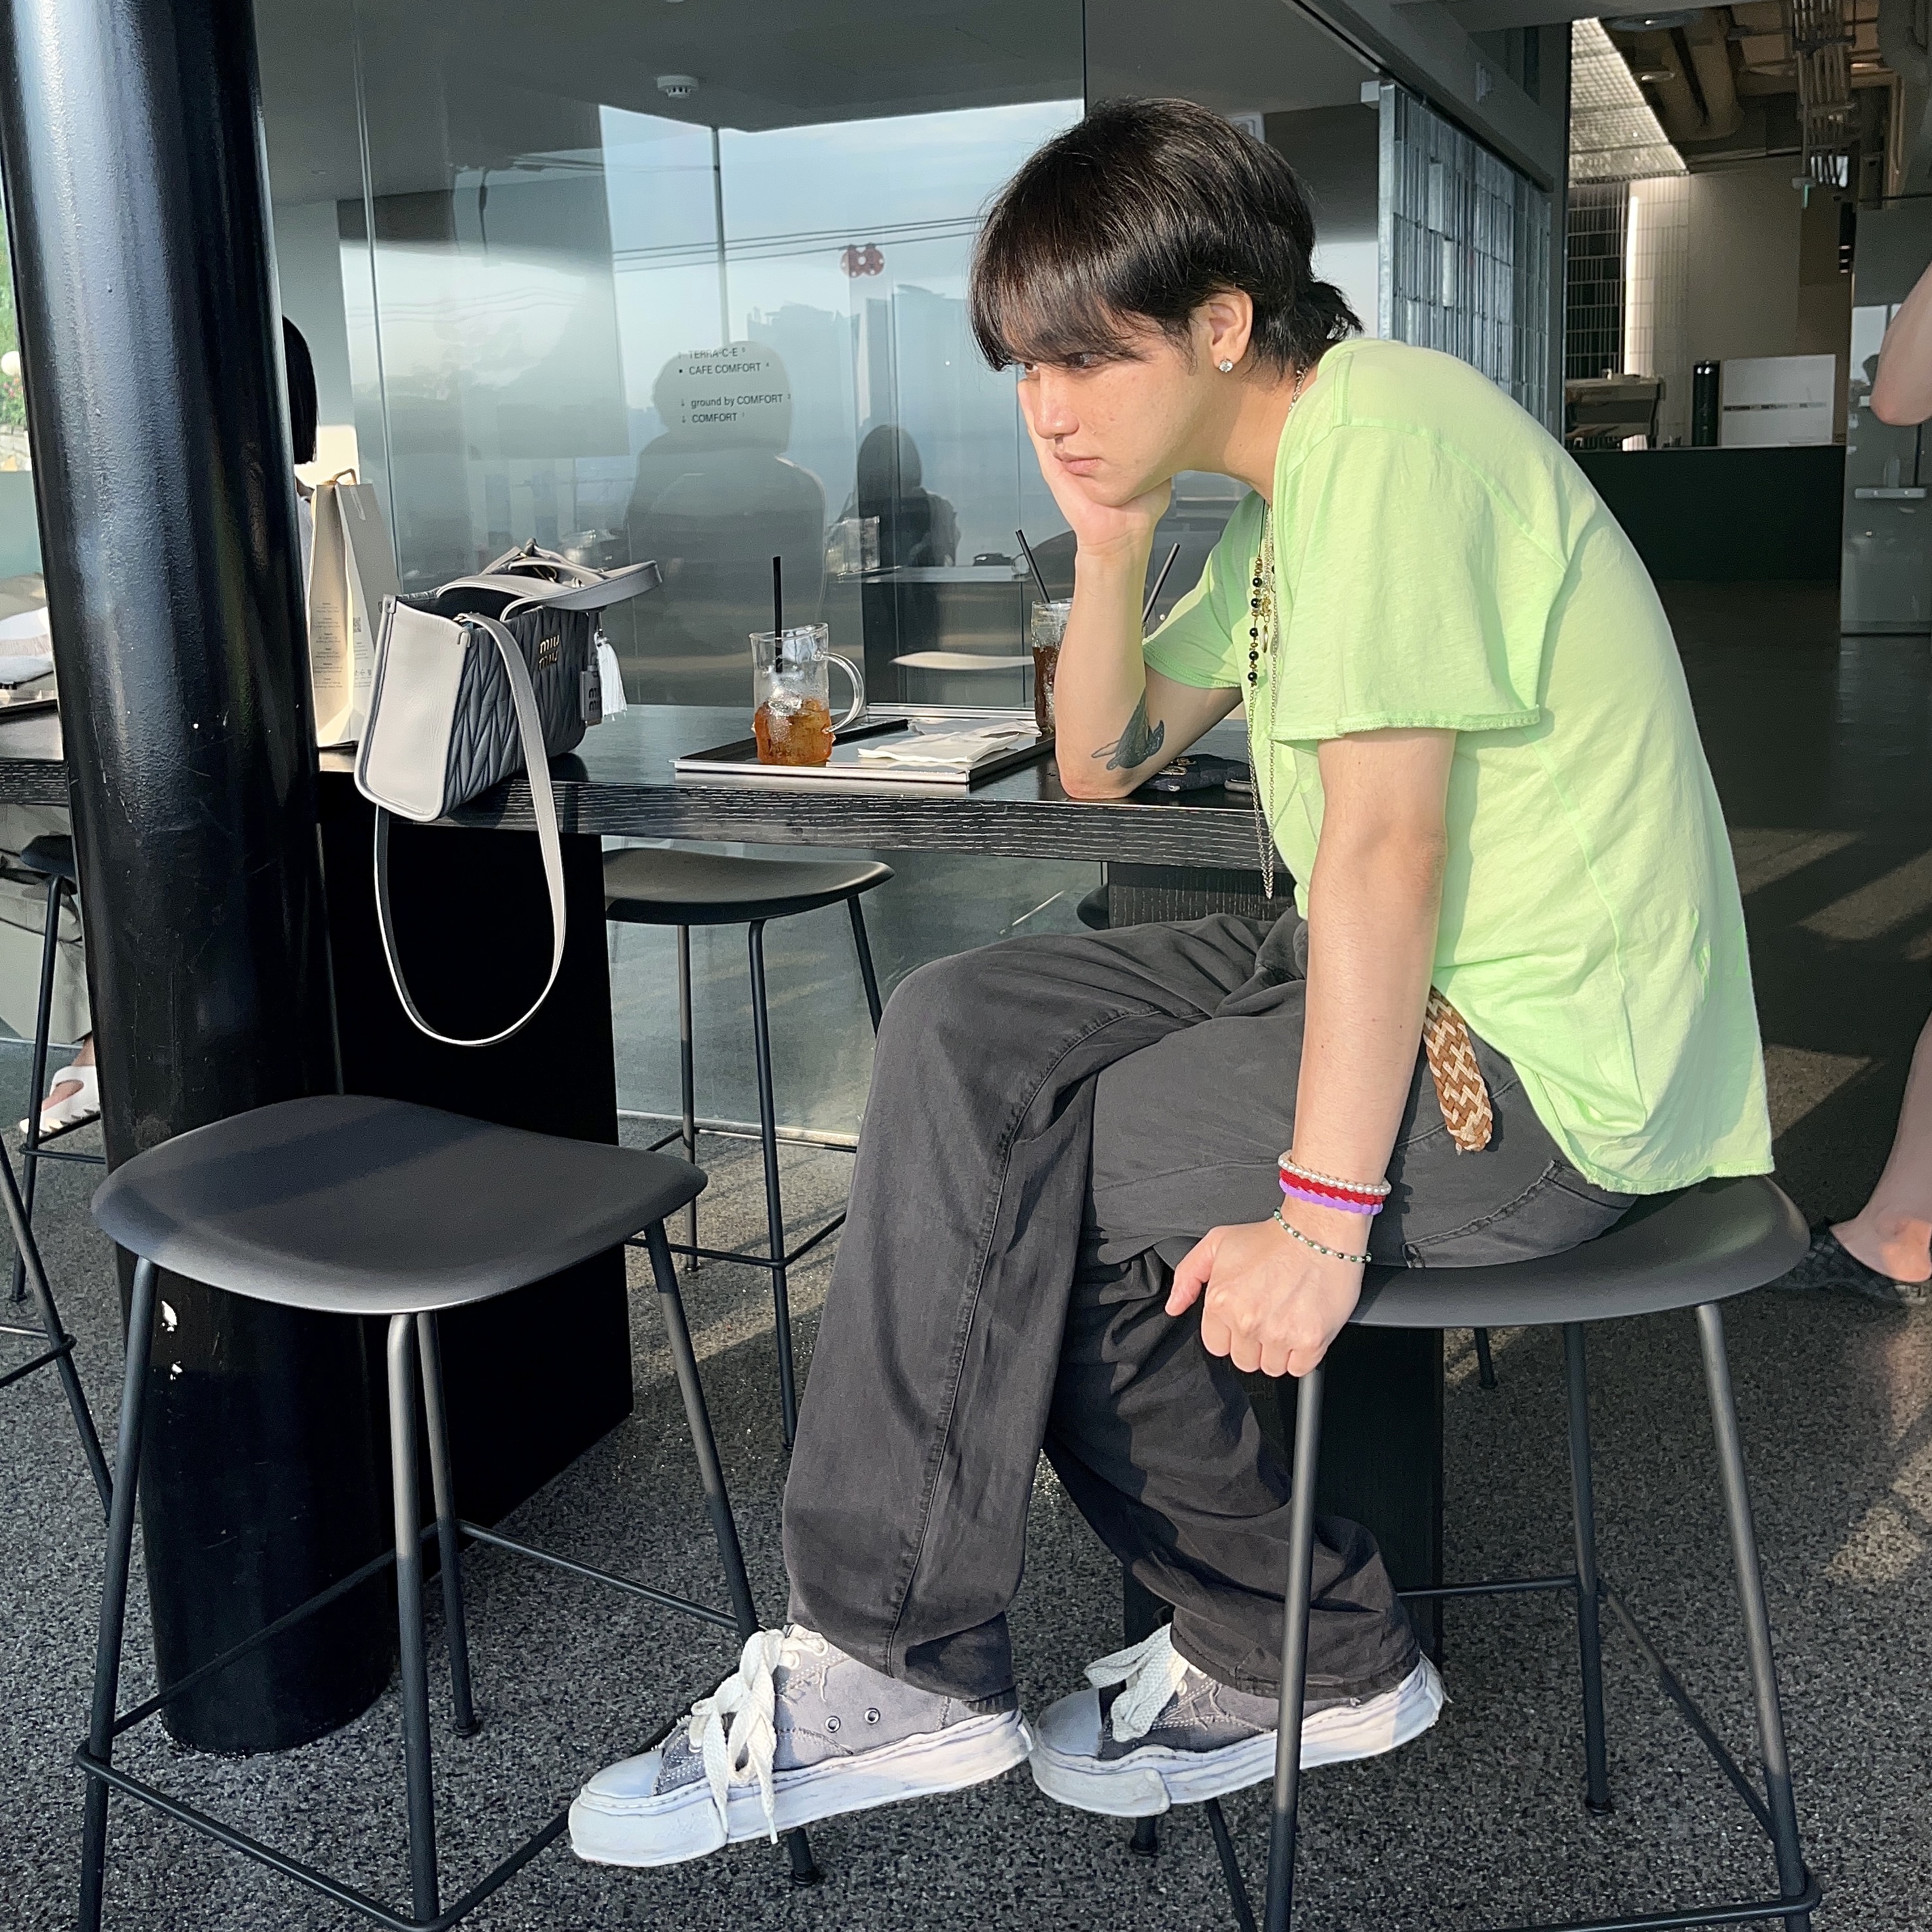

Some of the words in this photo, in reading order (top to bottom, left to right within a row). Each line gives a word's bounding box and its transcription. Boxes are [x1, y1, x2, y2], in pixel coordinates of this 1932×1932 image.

[689, 365, 713, 375] CAFE
[715, 363, 761, 374] COMFORT
[691, 397, 721, 409] ground
[724, 396, 734, 407] by
[737, 394, 783, 404] COMFORT
[692, 412, 738, 423] COMFORT
